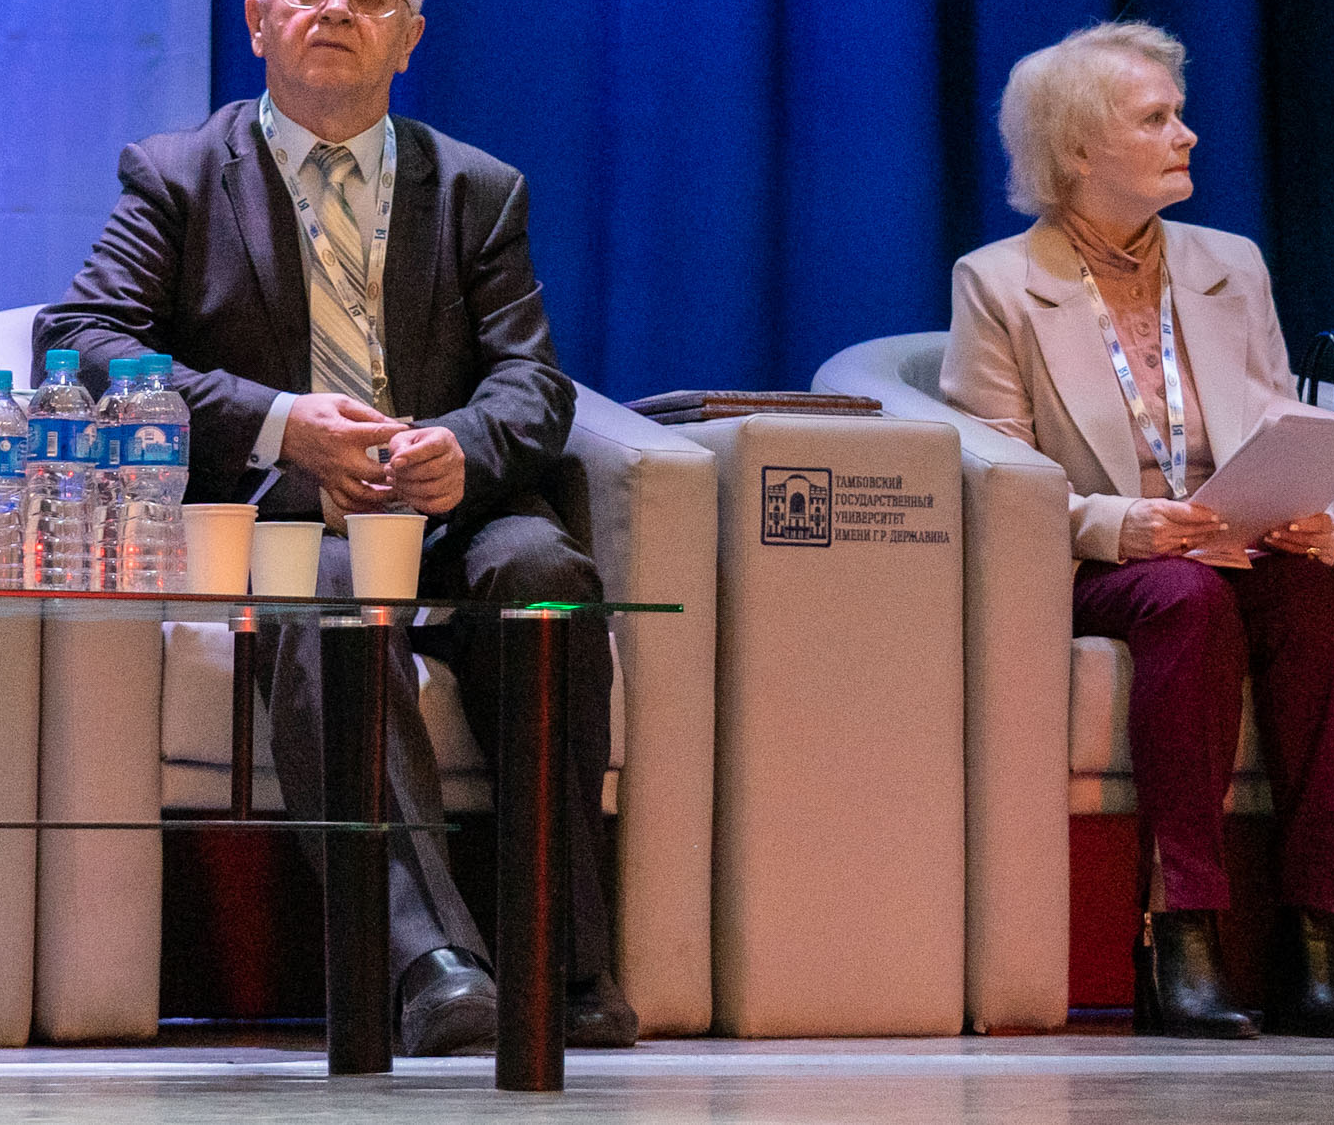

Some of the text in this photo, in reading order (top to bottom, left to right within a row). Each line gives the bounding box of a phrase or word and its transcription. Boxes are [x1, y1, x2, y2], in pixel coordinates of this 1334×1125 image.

[835, 475, 902, 489] ТАМБОВСКИЙ
[835, 493, 934, 508] ГОСУДАРСТВЕННЫЙ
[835, 511, 905, 525] УНИВЕРСИТЕТ
[835, 528, 870, 542] ИМЕНИ
[889, 529, 950, 544] ДЕРЖАВИНА
